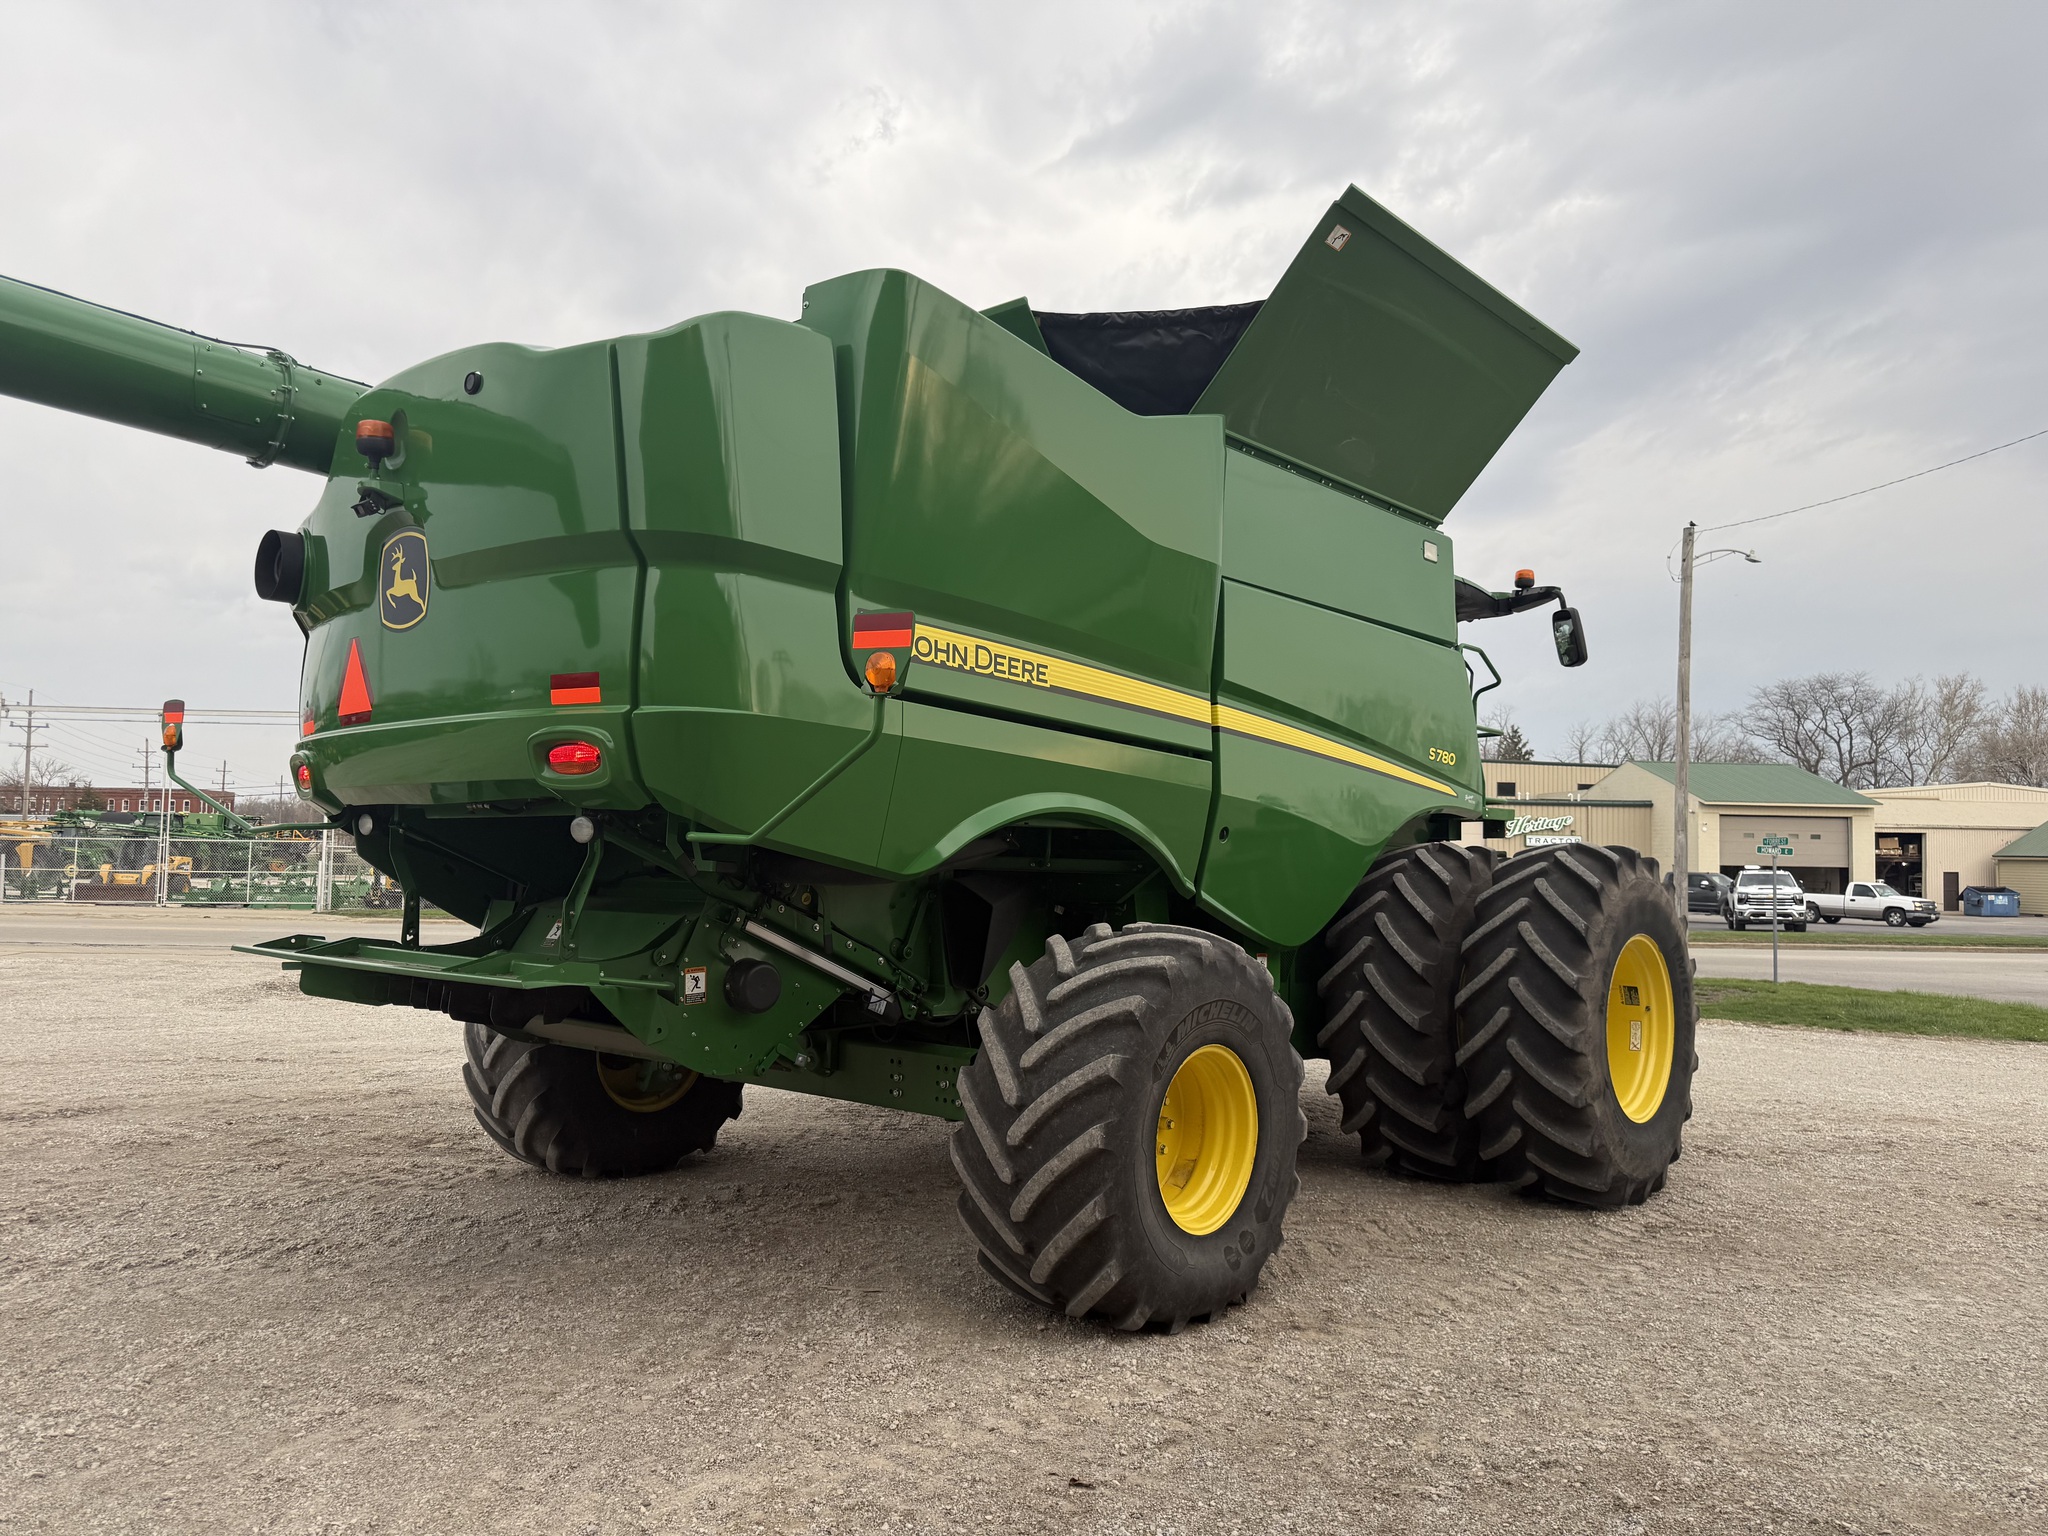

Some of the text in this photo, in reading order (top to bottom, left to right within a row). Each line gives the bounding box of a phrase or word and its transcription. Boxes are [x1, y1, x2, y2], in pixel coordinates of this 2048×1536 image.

[913, 635, 1049, 685] OHN DEERE
[1428, 748, 1456, 766] S780
[1505, 815, 1573, 839] Heritage
[1176, 1000, 1259, 1044] MICHELIN
